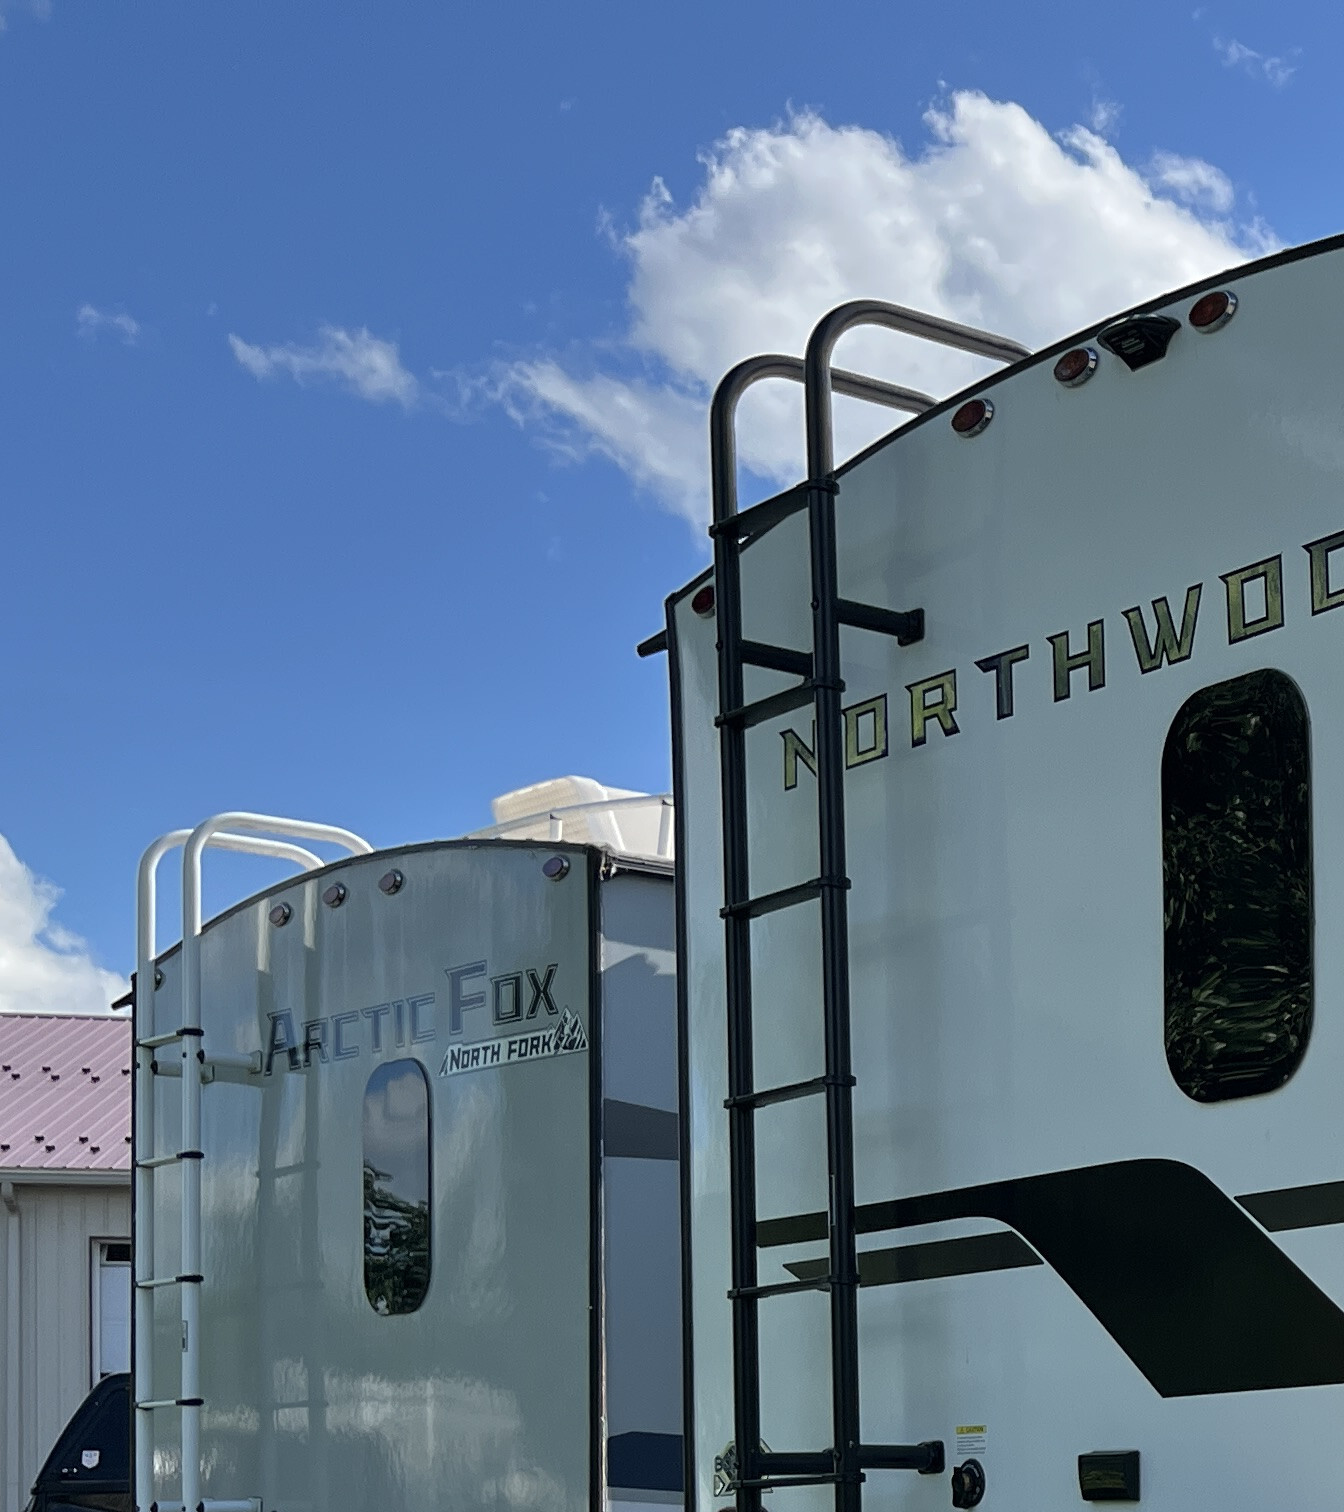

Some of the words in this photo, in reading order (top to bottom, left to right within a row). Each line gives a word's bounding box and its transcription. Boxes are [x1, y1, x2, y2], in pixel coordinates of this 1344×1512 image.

[264, 991, 437, 1077] ARCTIC
[444, 958, 560, 1036] FOX
[448, 1046, 501, 1072] NORTH
[507, 1033, 553, 1061] FORK
